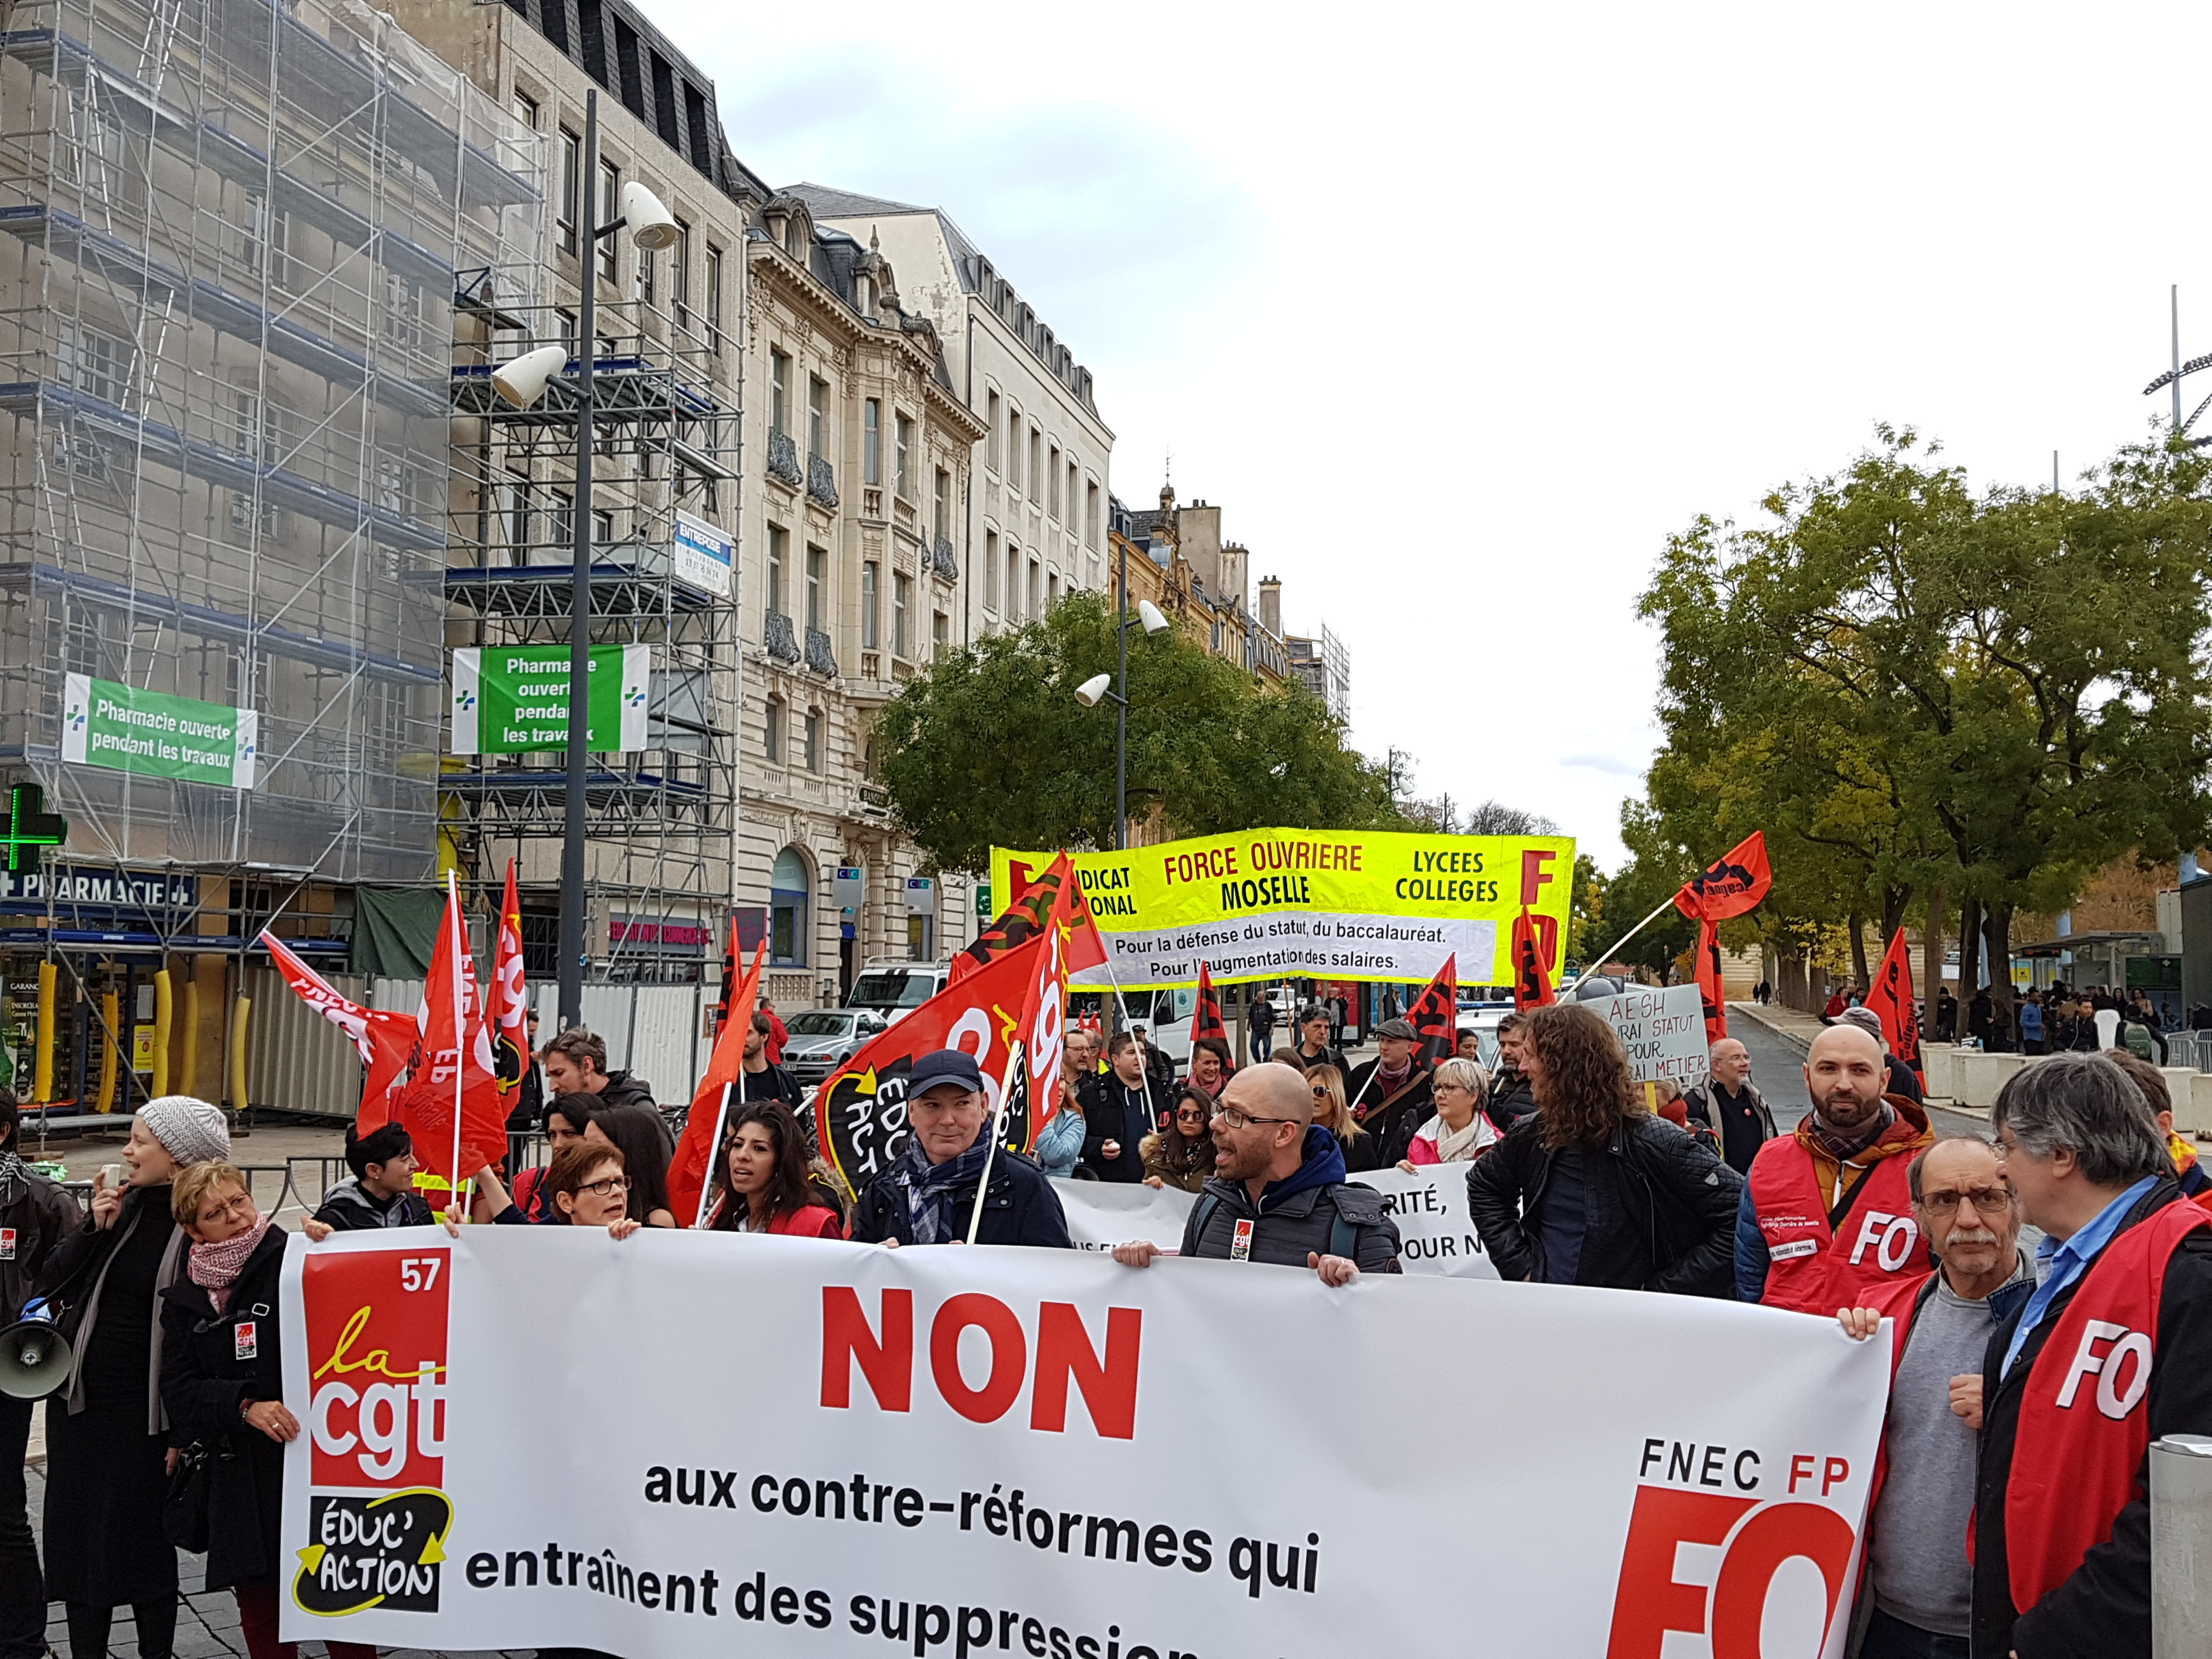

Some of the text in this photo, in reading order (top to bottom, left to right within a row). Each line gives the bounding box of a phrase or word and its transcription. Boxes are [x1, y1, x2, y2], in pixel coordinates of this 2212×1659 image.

[680, 523, 720, 554] ENTREPOSE
[507, 657, 596, 674] Pharmae
[518, 681, 571, 696] ouvert
[95, 699, 230, 741] Pharmacie ouverte
[515, 703, 569, 723] penda
[92, 732, 231, 768] pendant les travaux
[503, 727, 594, 742] les travax
[1164, 841, 1362, 885] FORCE OUVRIERE
[1413, 851, 1483, 873] LYCEES
[1222, 876, 1311, 911] MOSELLE
[1396, 878, 1498, 902] COLLEGES
[1115, 920, 1446, 954] Pour la défense du statut, du baccalauréat.
[1151, 962, 1188, 977] Pour
[1306, 948, 1327, 966] des
[1331, 951, 1399, 969] salaires.
[1610, 992, 1665, 1022] AESH
[1652, 1014, 1695, 1037] STATUT
[1627, 1041, 1664, 1059] POUR
[1634, 1053, 1706, 1081] AI MÉTIER
[845, 1099, 878, 1174] ACT
[1383, 1183, 1447, 1216] RITÉ,
[1, 1238, 14, 1248] cgt
[1235, 1234, 1249, 1246] cgt
[1464, 1234, 1482, 1255] N
[1849, 1210, 1918, 1272] FO
[402, 1257, 441, 1291] 57
[238, 1333, 253, 1345] cgt
[313, 1305, 446, 1380] la
[820, 1285, 1143, 1440] NON
[2056, 1319, 2153, 1419] FO
[311, 1361, 445, 1480] cgt
[1639, 1438, 1850, 1497] FNEC FP
[321, 1499, 413, 1548] ÉDUC'
[645, 1464, 1319, 1599] aux contre-réformes qui
[320, 1549, 434, 1596] ACTION
[465, 1542, 719, 1616] entraînent
[734, 1572, 832, 1629] des
[1606, 1484, 1856, 1659] FO
